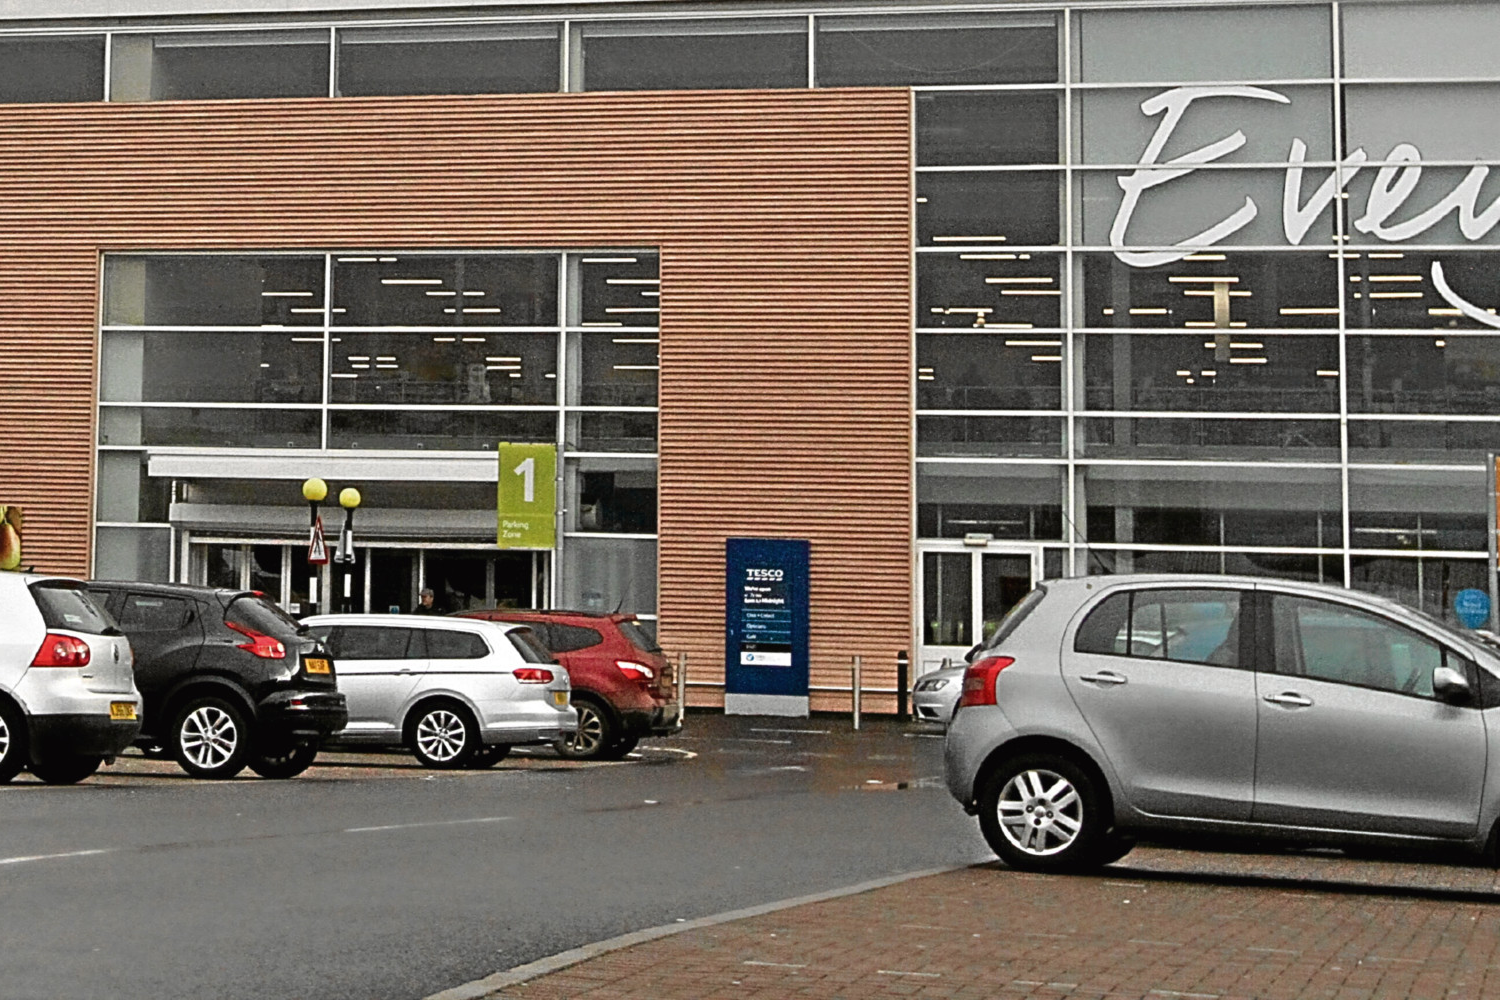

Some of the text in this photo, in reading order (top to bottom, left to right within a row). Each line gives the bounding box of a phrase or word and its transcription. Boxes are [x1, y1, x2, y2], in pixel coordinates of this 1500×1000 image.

[514, 458, 534, 502] 1
[503, 521, 529, 530] Parking
[503, 530, 521, 538] Zone
[746, 569, 784, 577] TESCO
